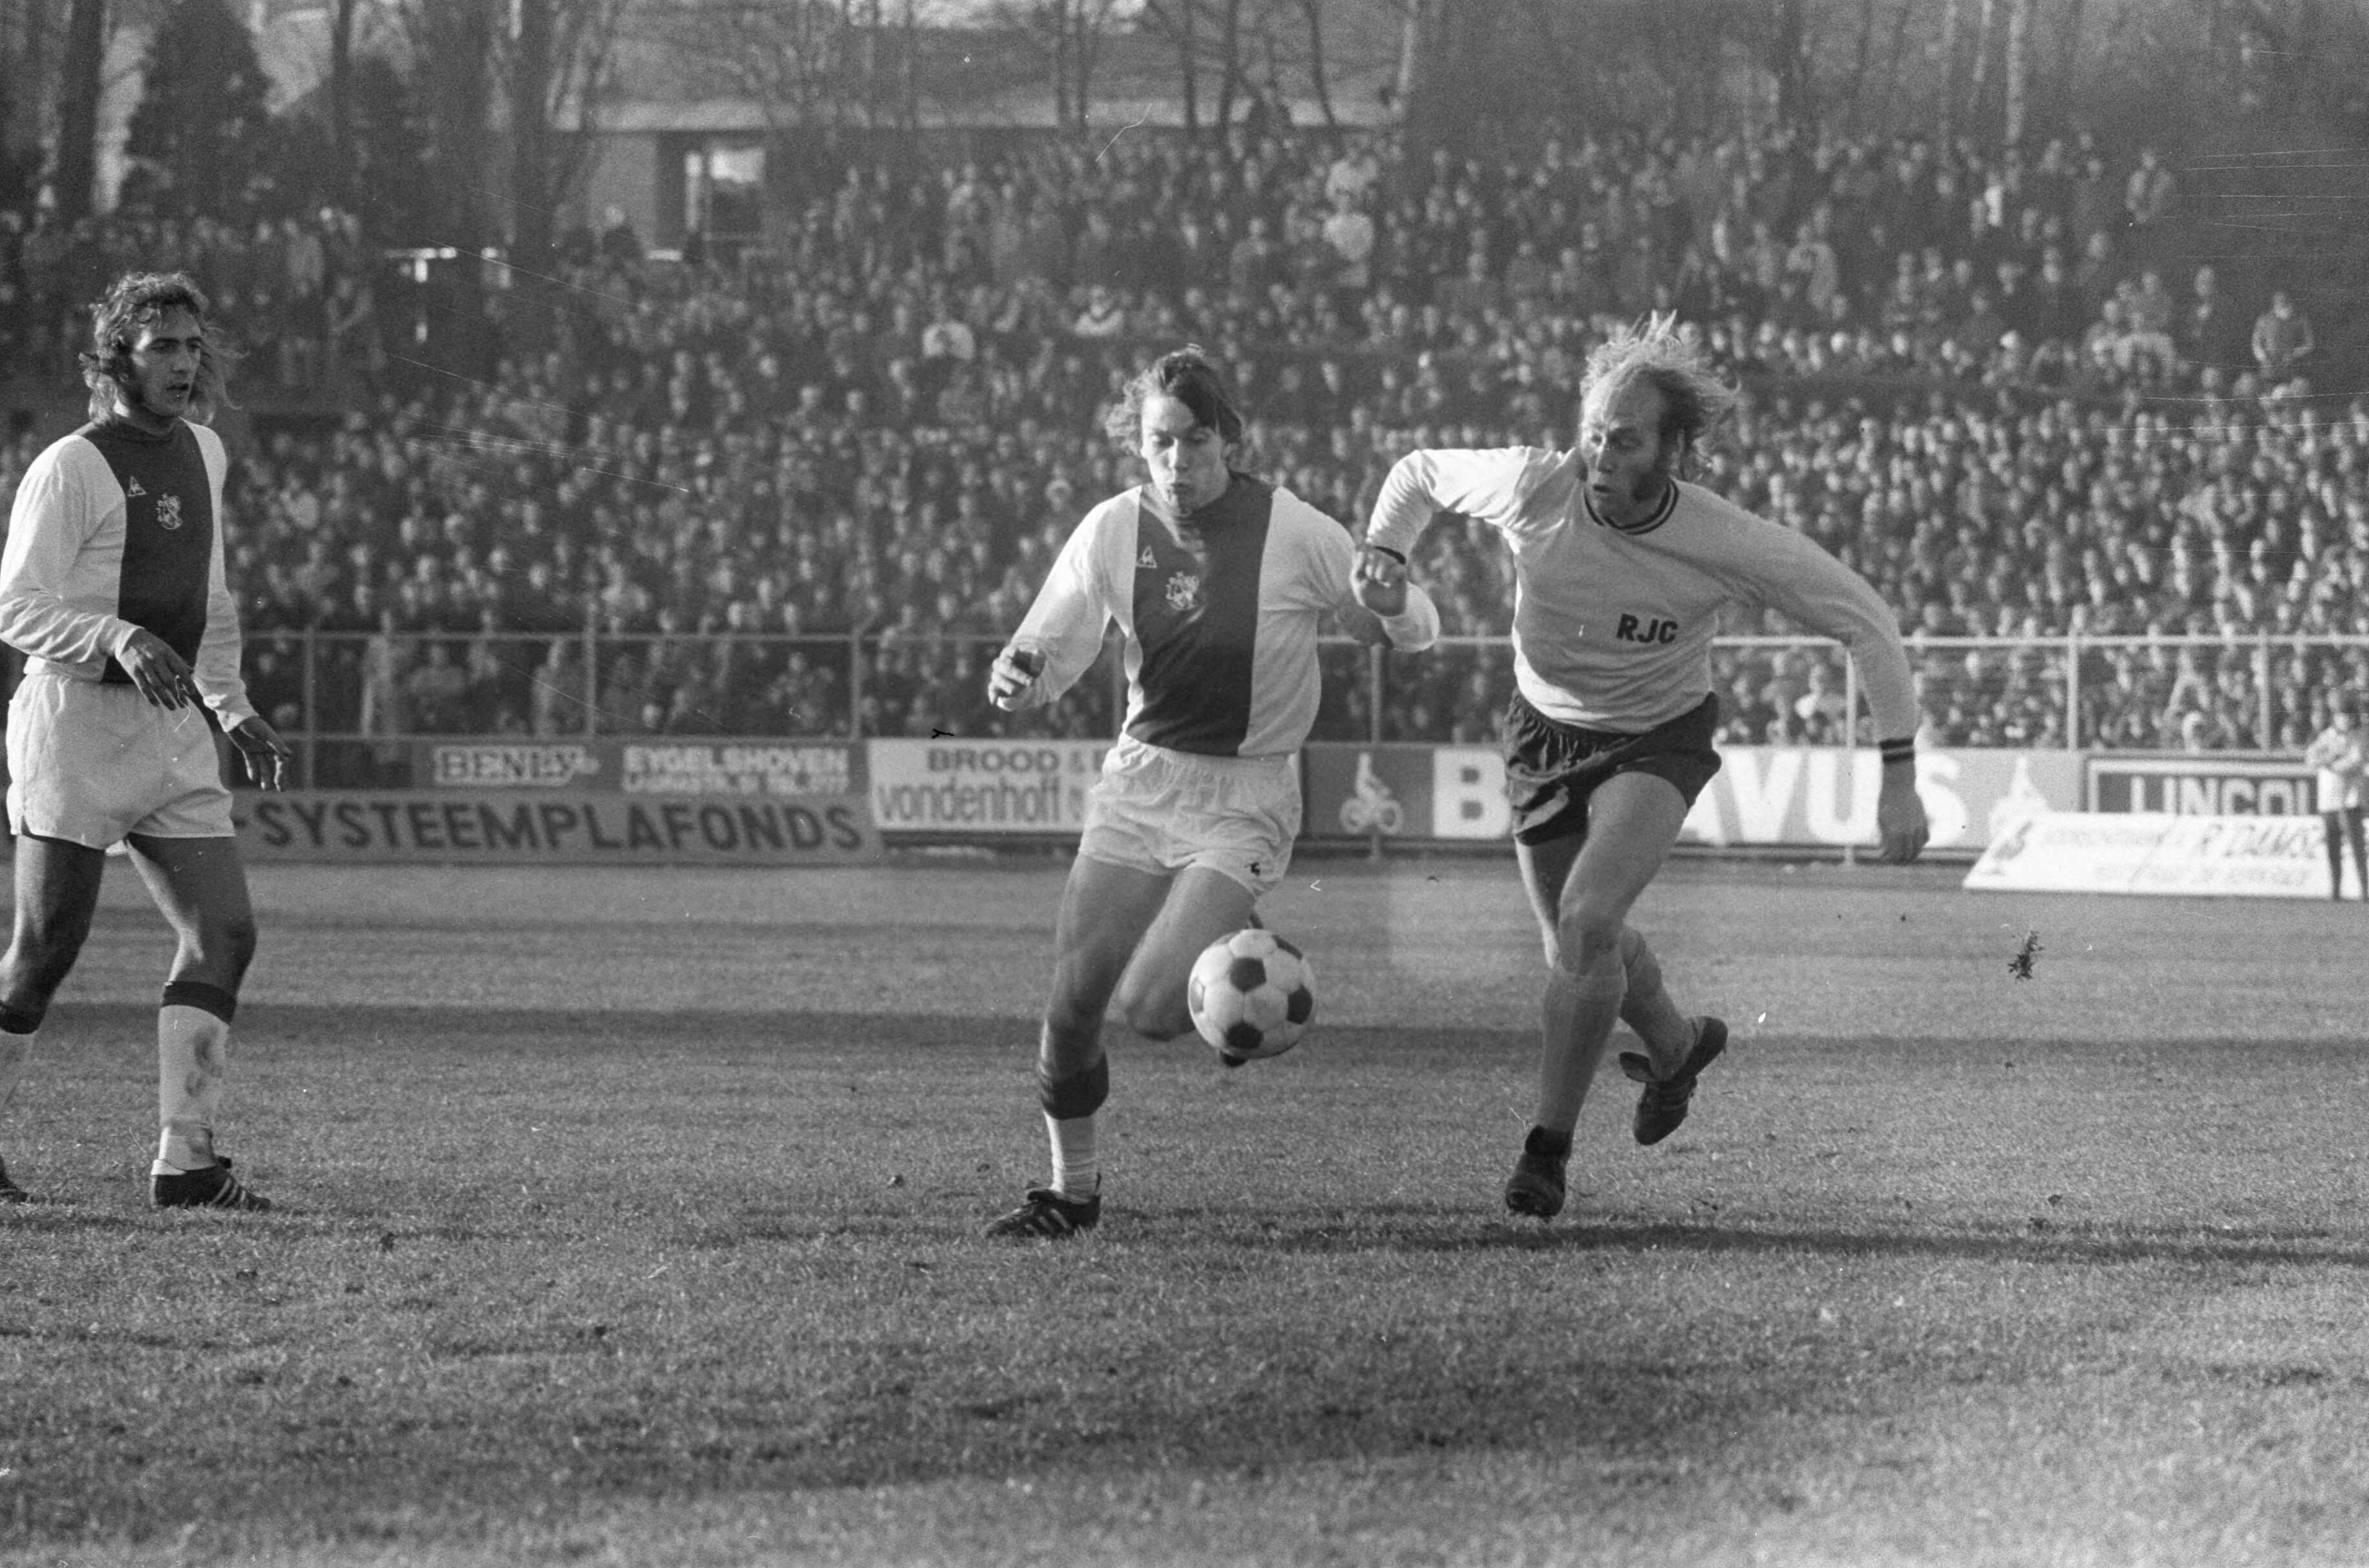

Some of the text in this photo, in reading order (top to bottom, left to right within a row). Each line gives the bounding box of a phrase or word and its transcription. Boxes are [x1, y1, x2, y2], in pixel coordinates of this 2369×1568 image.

[1617, 613, 1678, 644] RJC
[928, 748, 1060, 773] BROOD
[259, 800, 863, 852] SYSTEEMPLAFONDS
